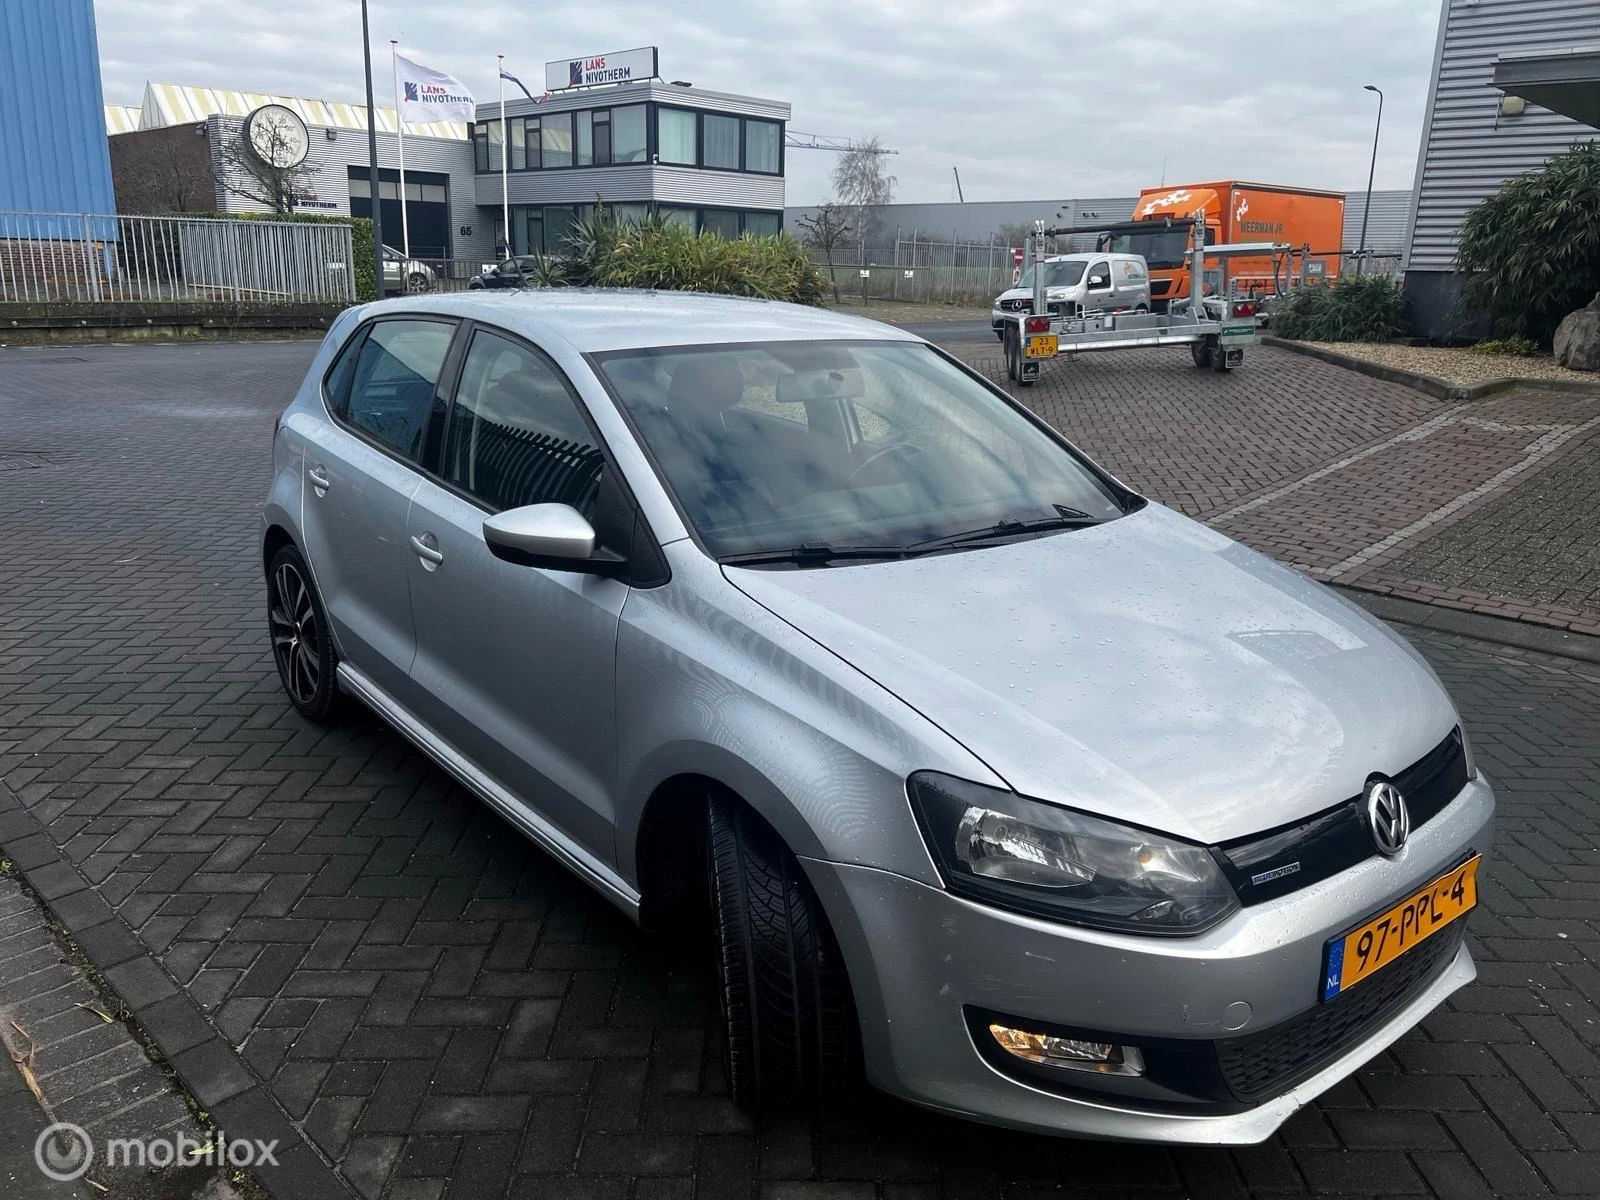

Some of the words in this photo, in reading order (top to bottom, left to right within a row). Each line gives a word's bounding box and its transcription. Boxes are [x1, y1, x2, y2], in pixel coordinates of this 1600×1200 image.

[585, 57, 606, 71] LANS
[585, 66, 631, 84] NIVOTHERM
[420, 84, 446, 95] LANS
[460, 226, 472, 236] 65
[1240, 220, 1274, 234] MEERMAN
[1039, 337, 1049, 346] 23
[1030, 346, 1054, 355] WLT-9
[1357, 870, 1466, 974] 97-PPL-4
[1326, 974, 1340, 990] NL
